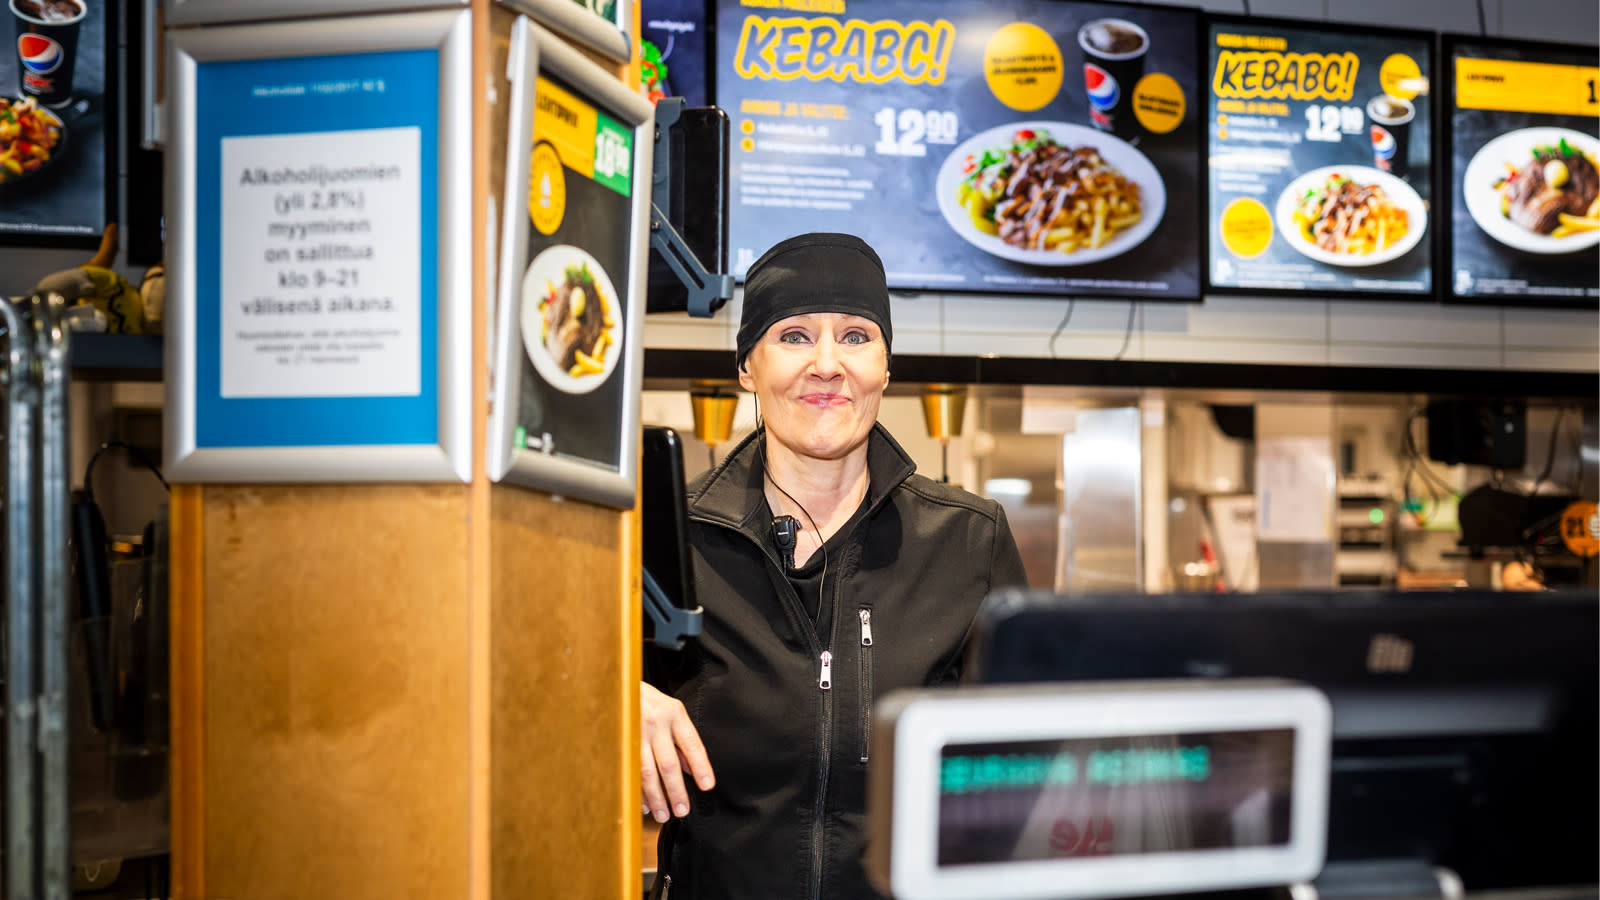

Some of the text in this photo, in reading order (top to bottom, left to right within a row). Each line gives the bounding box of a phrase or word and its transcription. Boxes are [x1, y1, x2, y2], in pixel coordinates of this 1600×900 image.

[734, 15, 956, 85] KEBABC!
[1213, 50, 1360, 101] KEBABC!
[240, 163, 402, 187] Alkoholijuomien
[274, 193, 305, 215] (yli
[267, 217, 372, 240] myyminen
[264, 244, 374, 263] on sallittua
[278, 270, 308, 289] klo
[240, 296, 322, 317] välisenä
